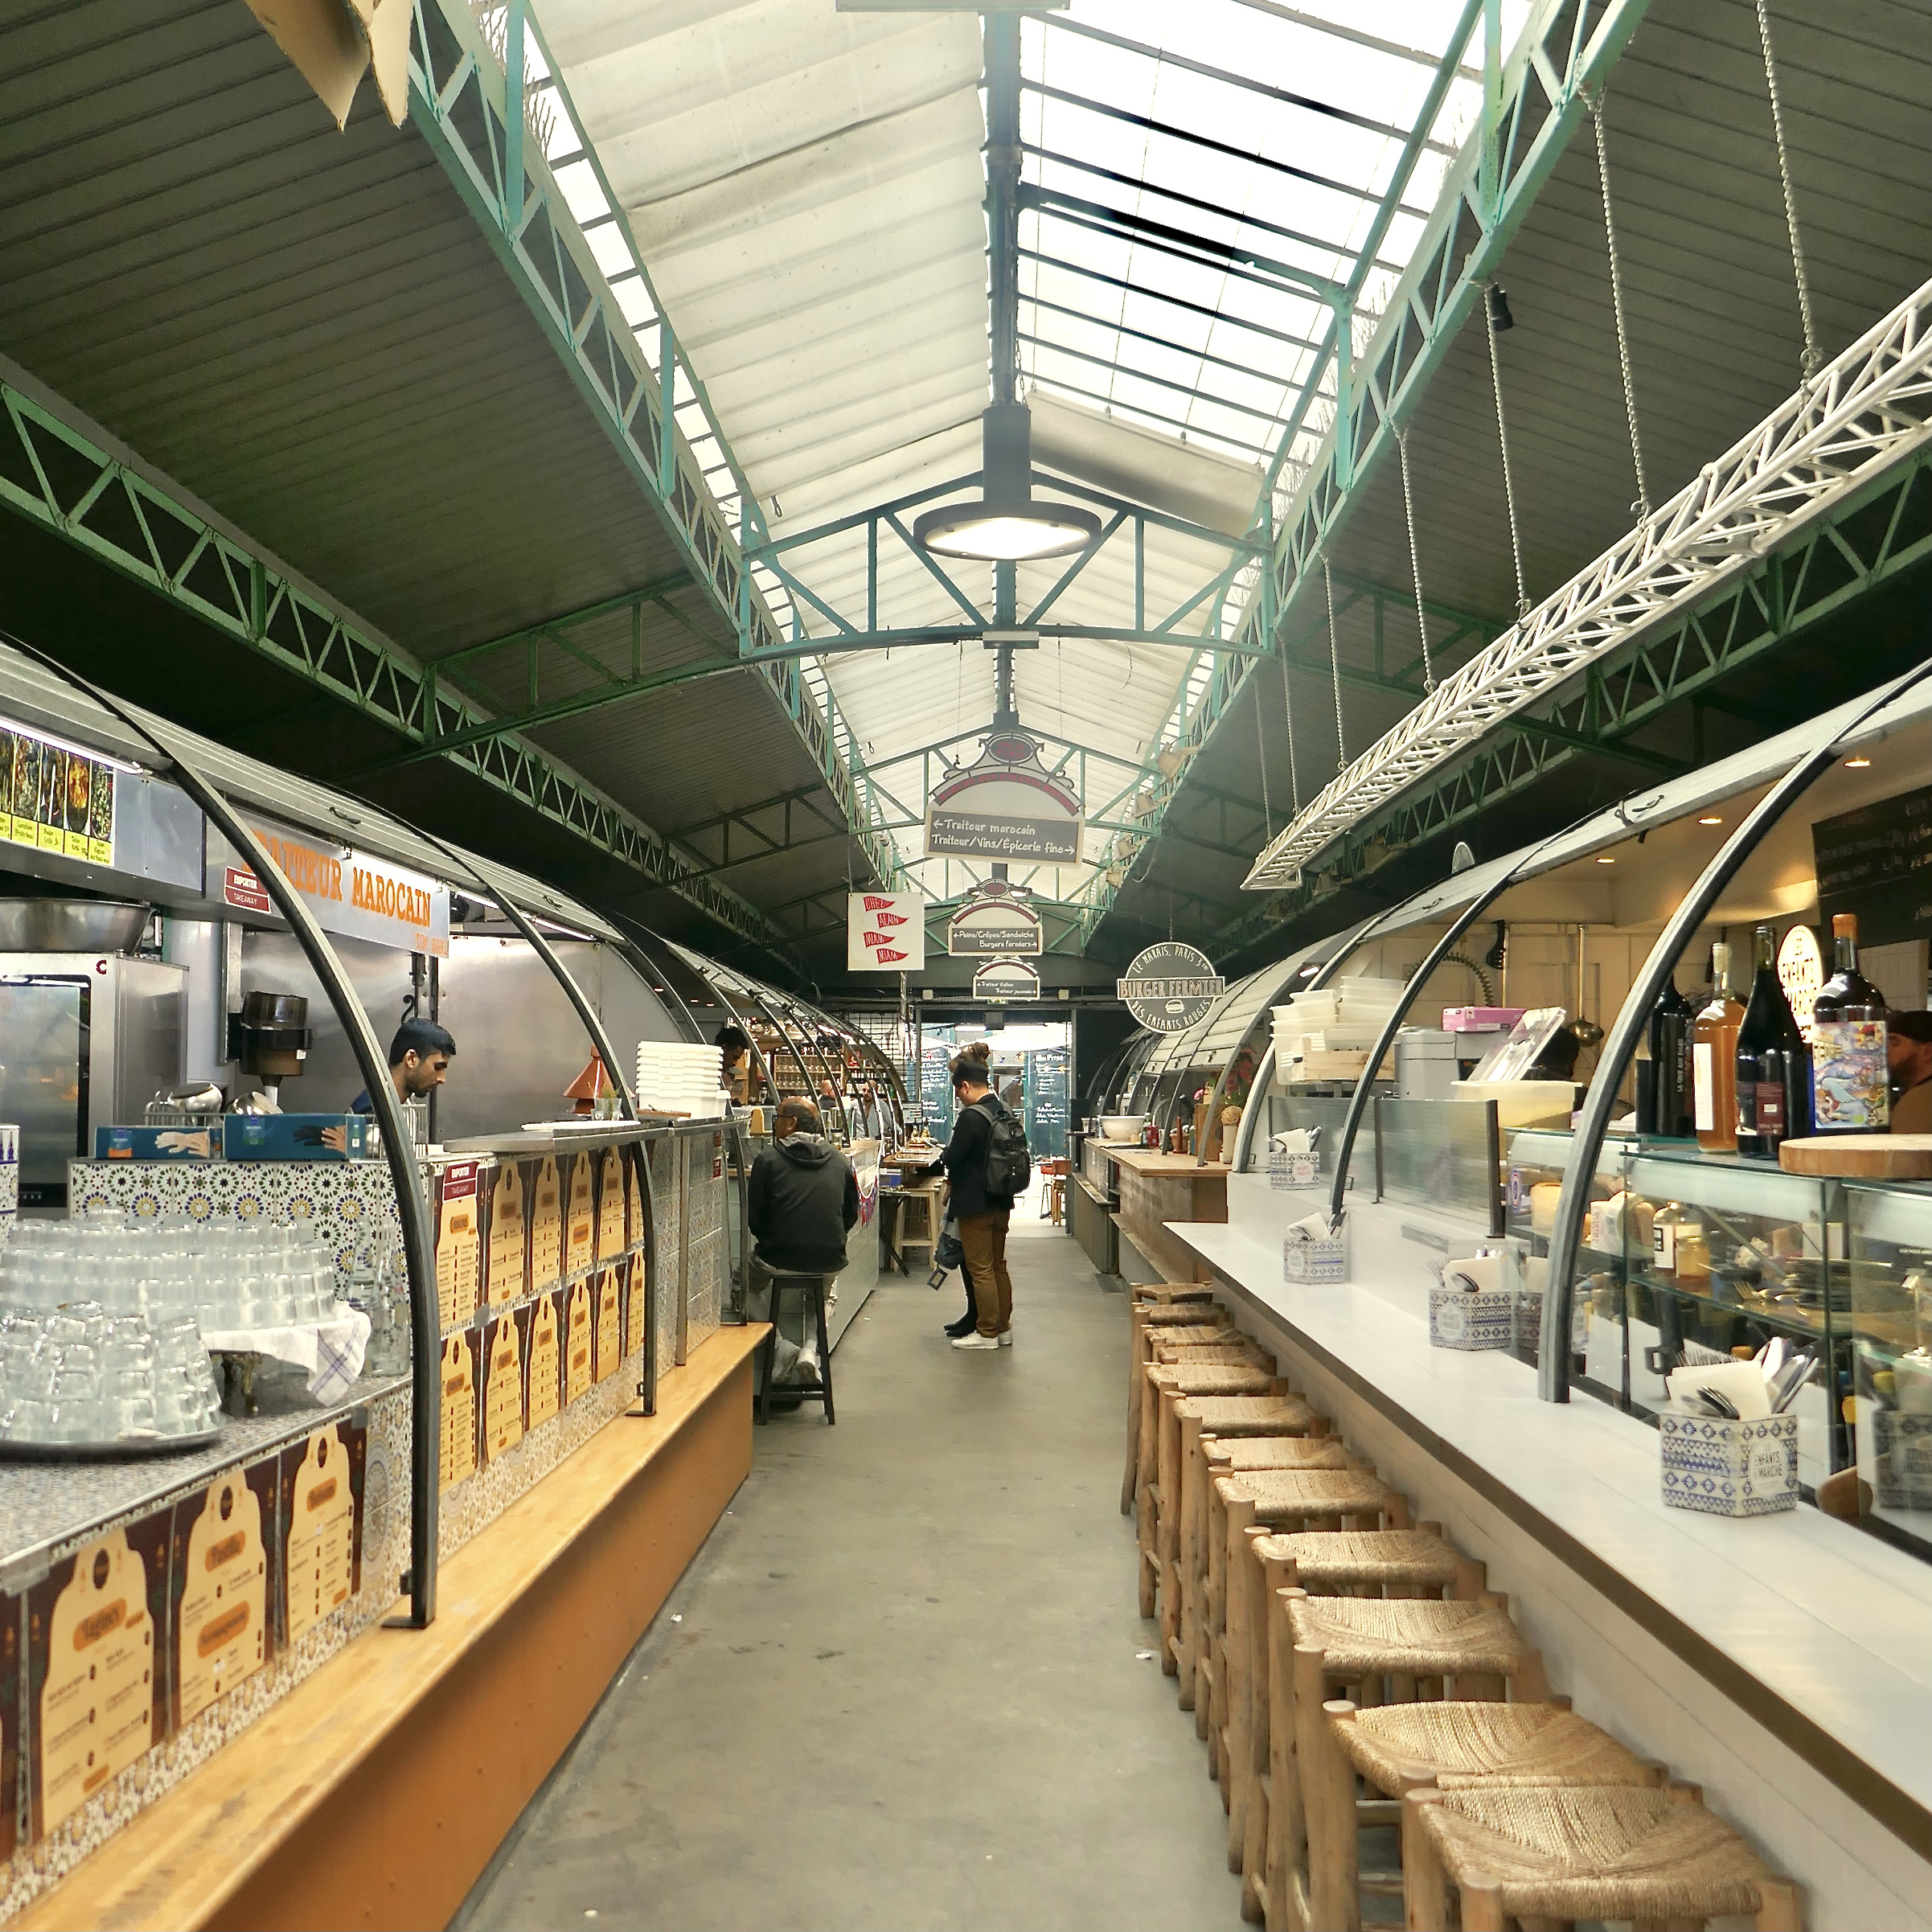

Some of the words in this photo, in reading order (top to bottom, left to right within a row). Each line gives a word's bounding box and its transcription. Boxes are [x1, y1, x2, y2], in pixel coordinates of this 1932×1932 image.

[944, 819, 986, 832] Traiteur
[990, 824, 1036, 835] marocain
[932, 834, 1041, 854] Traiteur/Vins/Épicerie
[1044, 843, 1064, 854] fine
[243, 828, 343, 902] AITEUR
[351, 866, 431, 928] MAROCAIN
[233, 892, 257, 904] TAKEAWAY
[864, 897, 884, 910] CHEZ
[879, 913, 899, 926] ALAIN
[865, 933, 885, 945] MIAM
[978, 940, 1004, 949] Burgers
[878, 950, 898, 962] MIAM
[1132, 962, 1143, 974] LE
[1175, 945, 1196, 962] PARIS
[1119, 981, 1165, 997] BURGER
[1168, 979, 1223, 997] FERMIER
[1131, 1000, 1145, 1019] DES
[1146, 1014, 1181, 1030] ENFANTS
[1183, 999, 1211, 1027] ROUGES
[1754, 1450, 1780, 1467] ENFANTS
